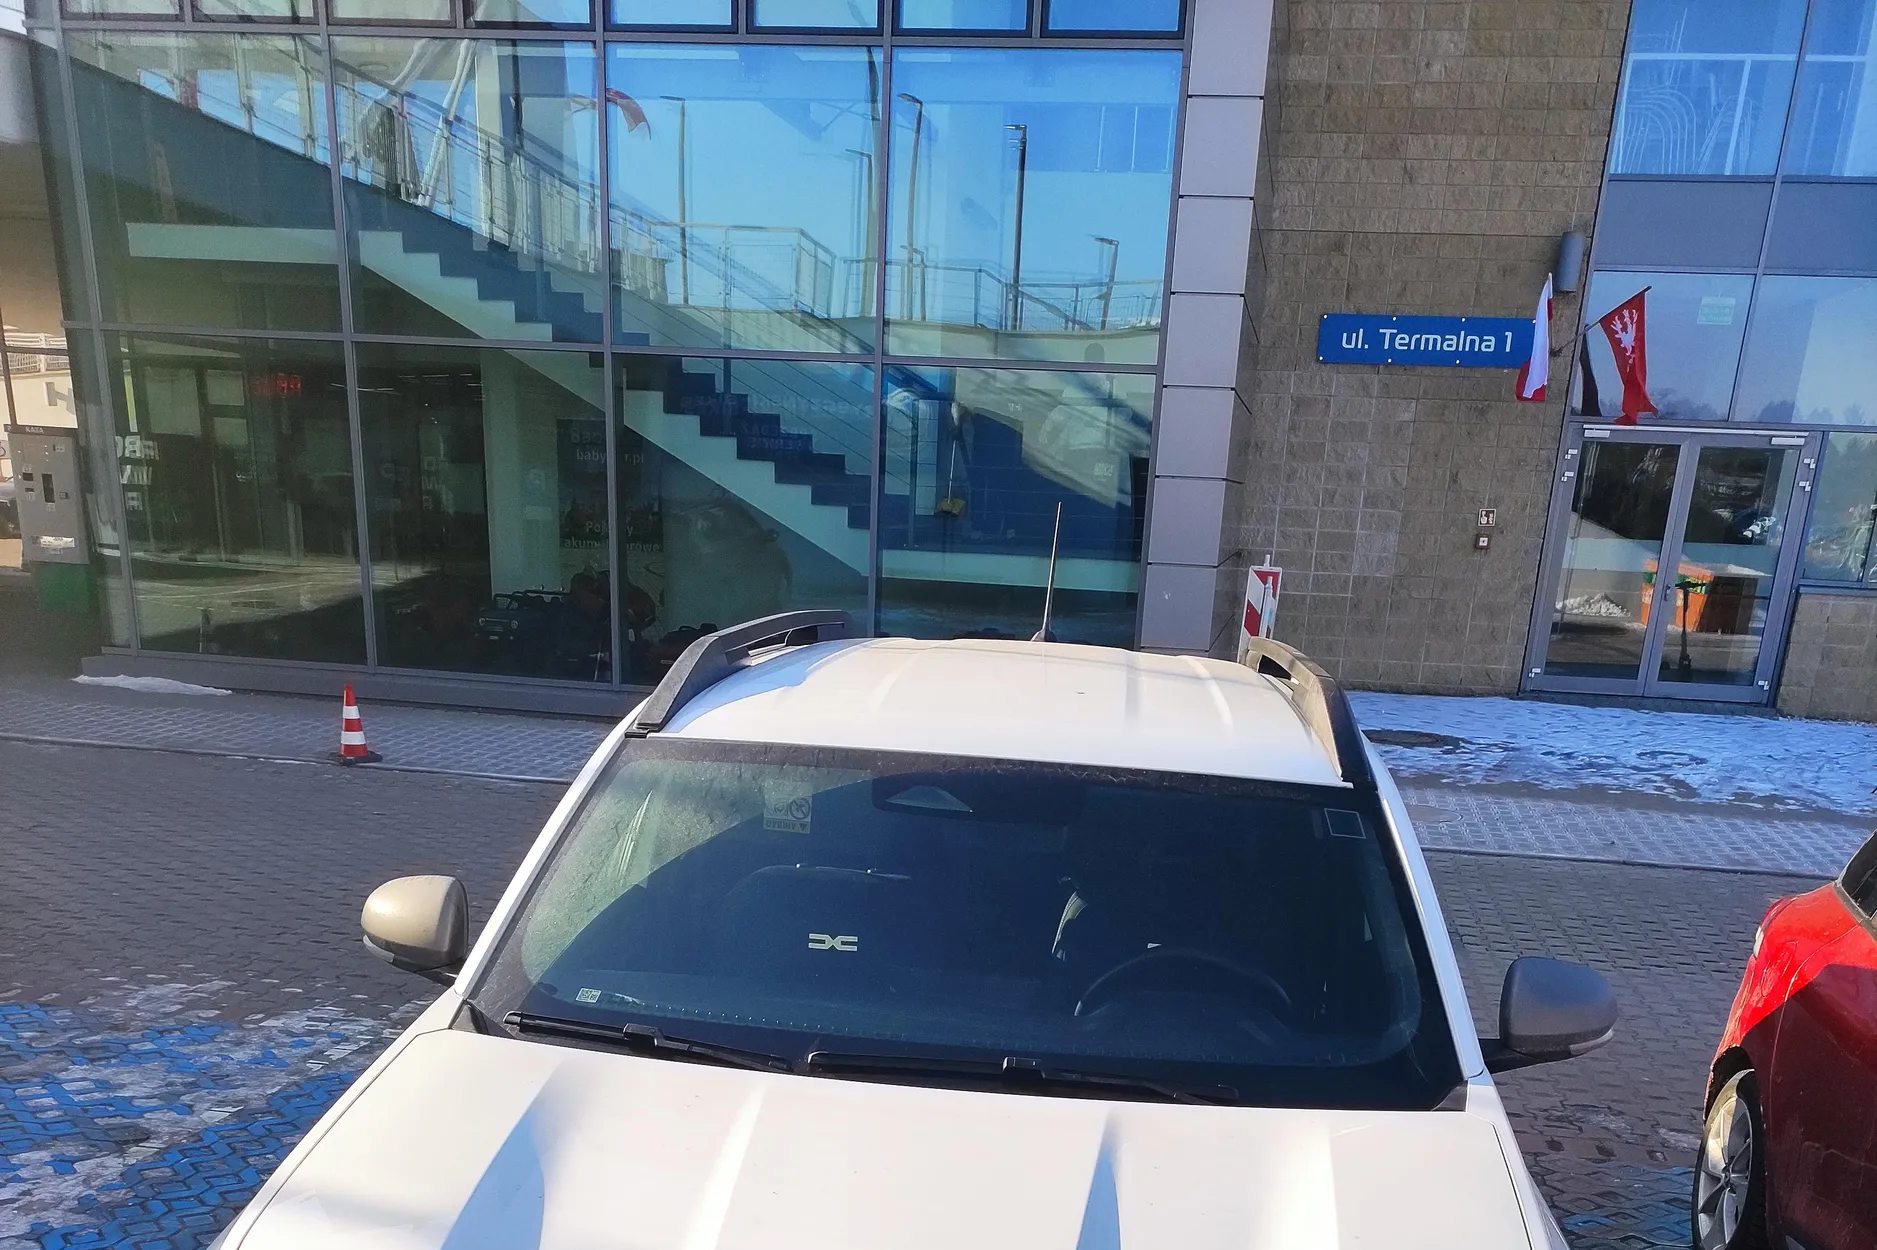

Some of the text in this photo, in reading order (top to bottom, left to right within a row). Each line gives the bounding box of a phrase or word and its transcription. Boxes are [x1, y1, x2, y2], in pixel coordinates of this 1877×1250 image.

[1341, 328, 1513, 353] ul. Termalna 1
